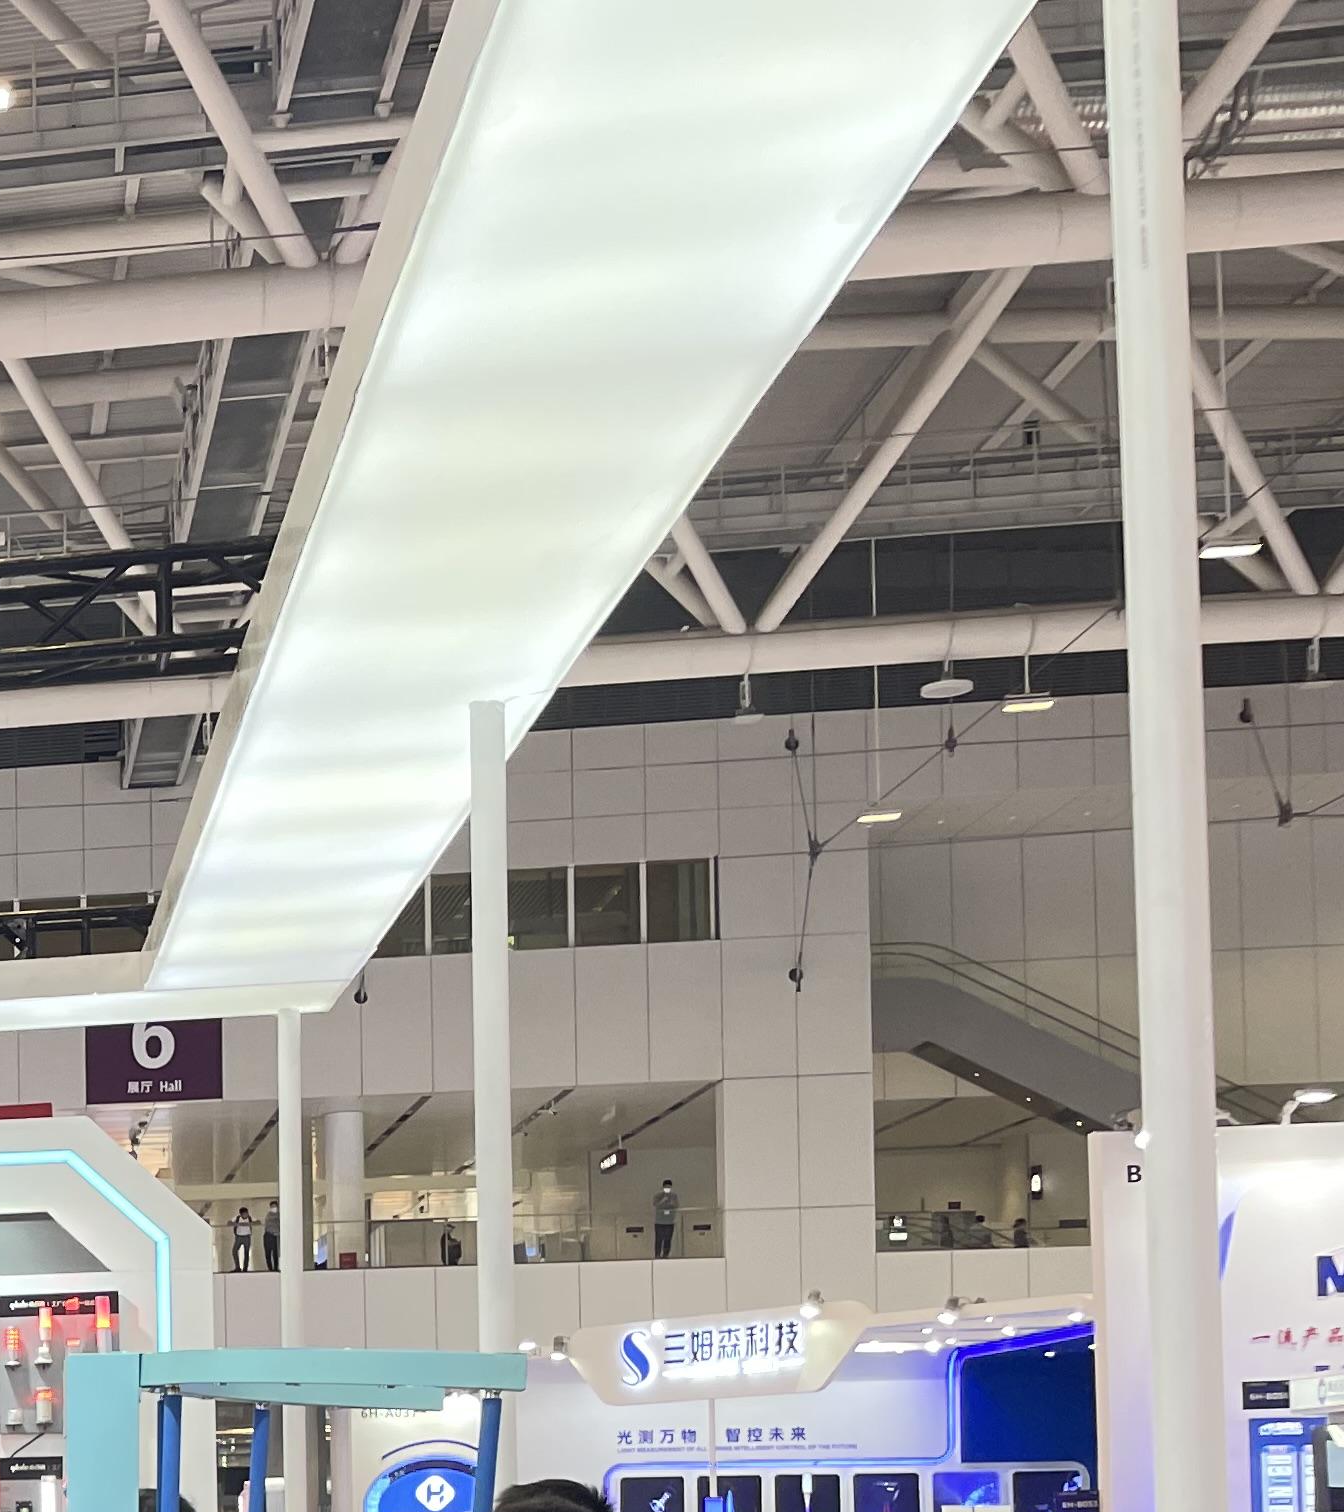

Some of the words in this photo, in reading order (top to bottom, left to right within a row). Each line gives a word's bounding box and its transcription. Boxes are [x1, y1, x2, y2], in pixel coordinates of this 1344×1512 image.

[132, 1023, 175, 1069] 6
[127, 1081, 153, 1093] 展厅
[160, 1080, 182, 1092] Hall
[664, 1321, 799, 1365] 三姆森科技
[616, 1429, 697, 1445] 光测万物
[725, 1426, 807, 1443] 智控未来
